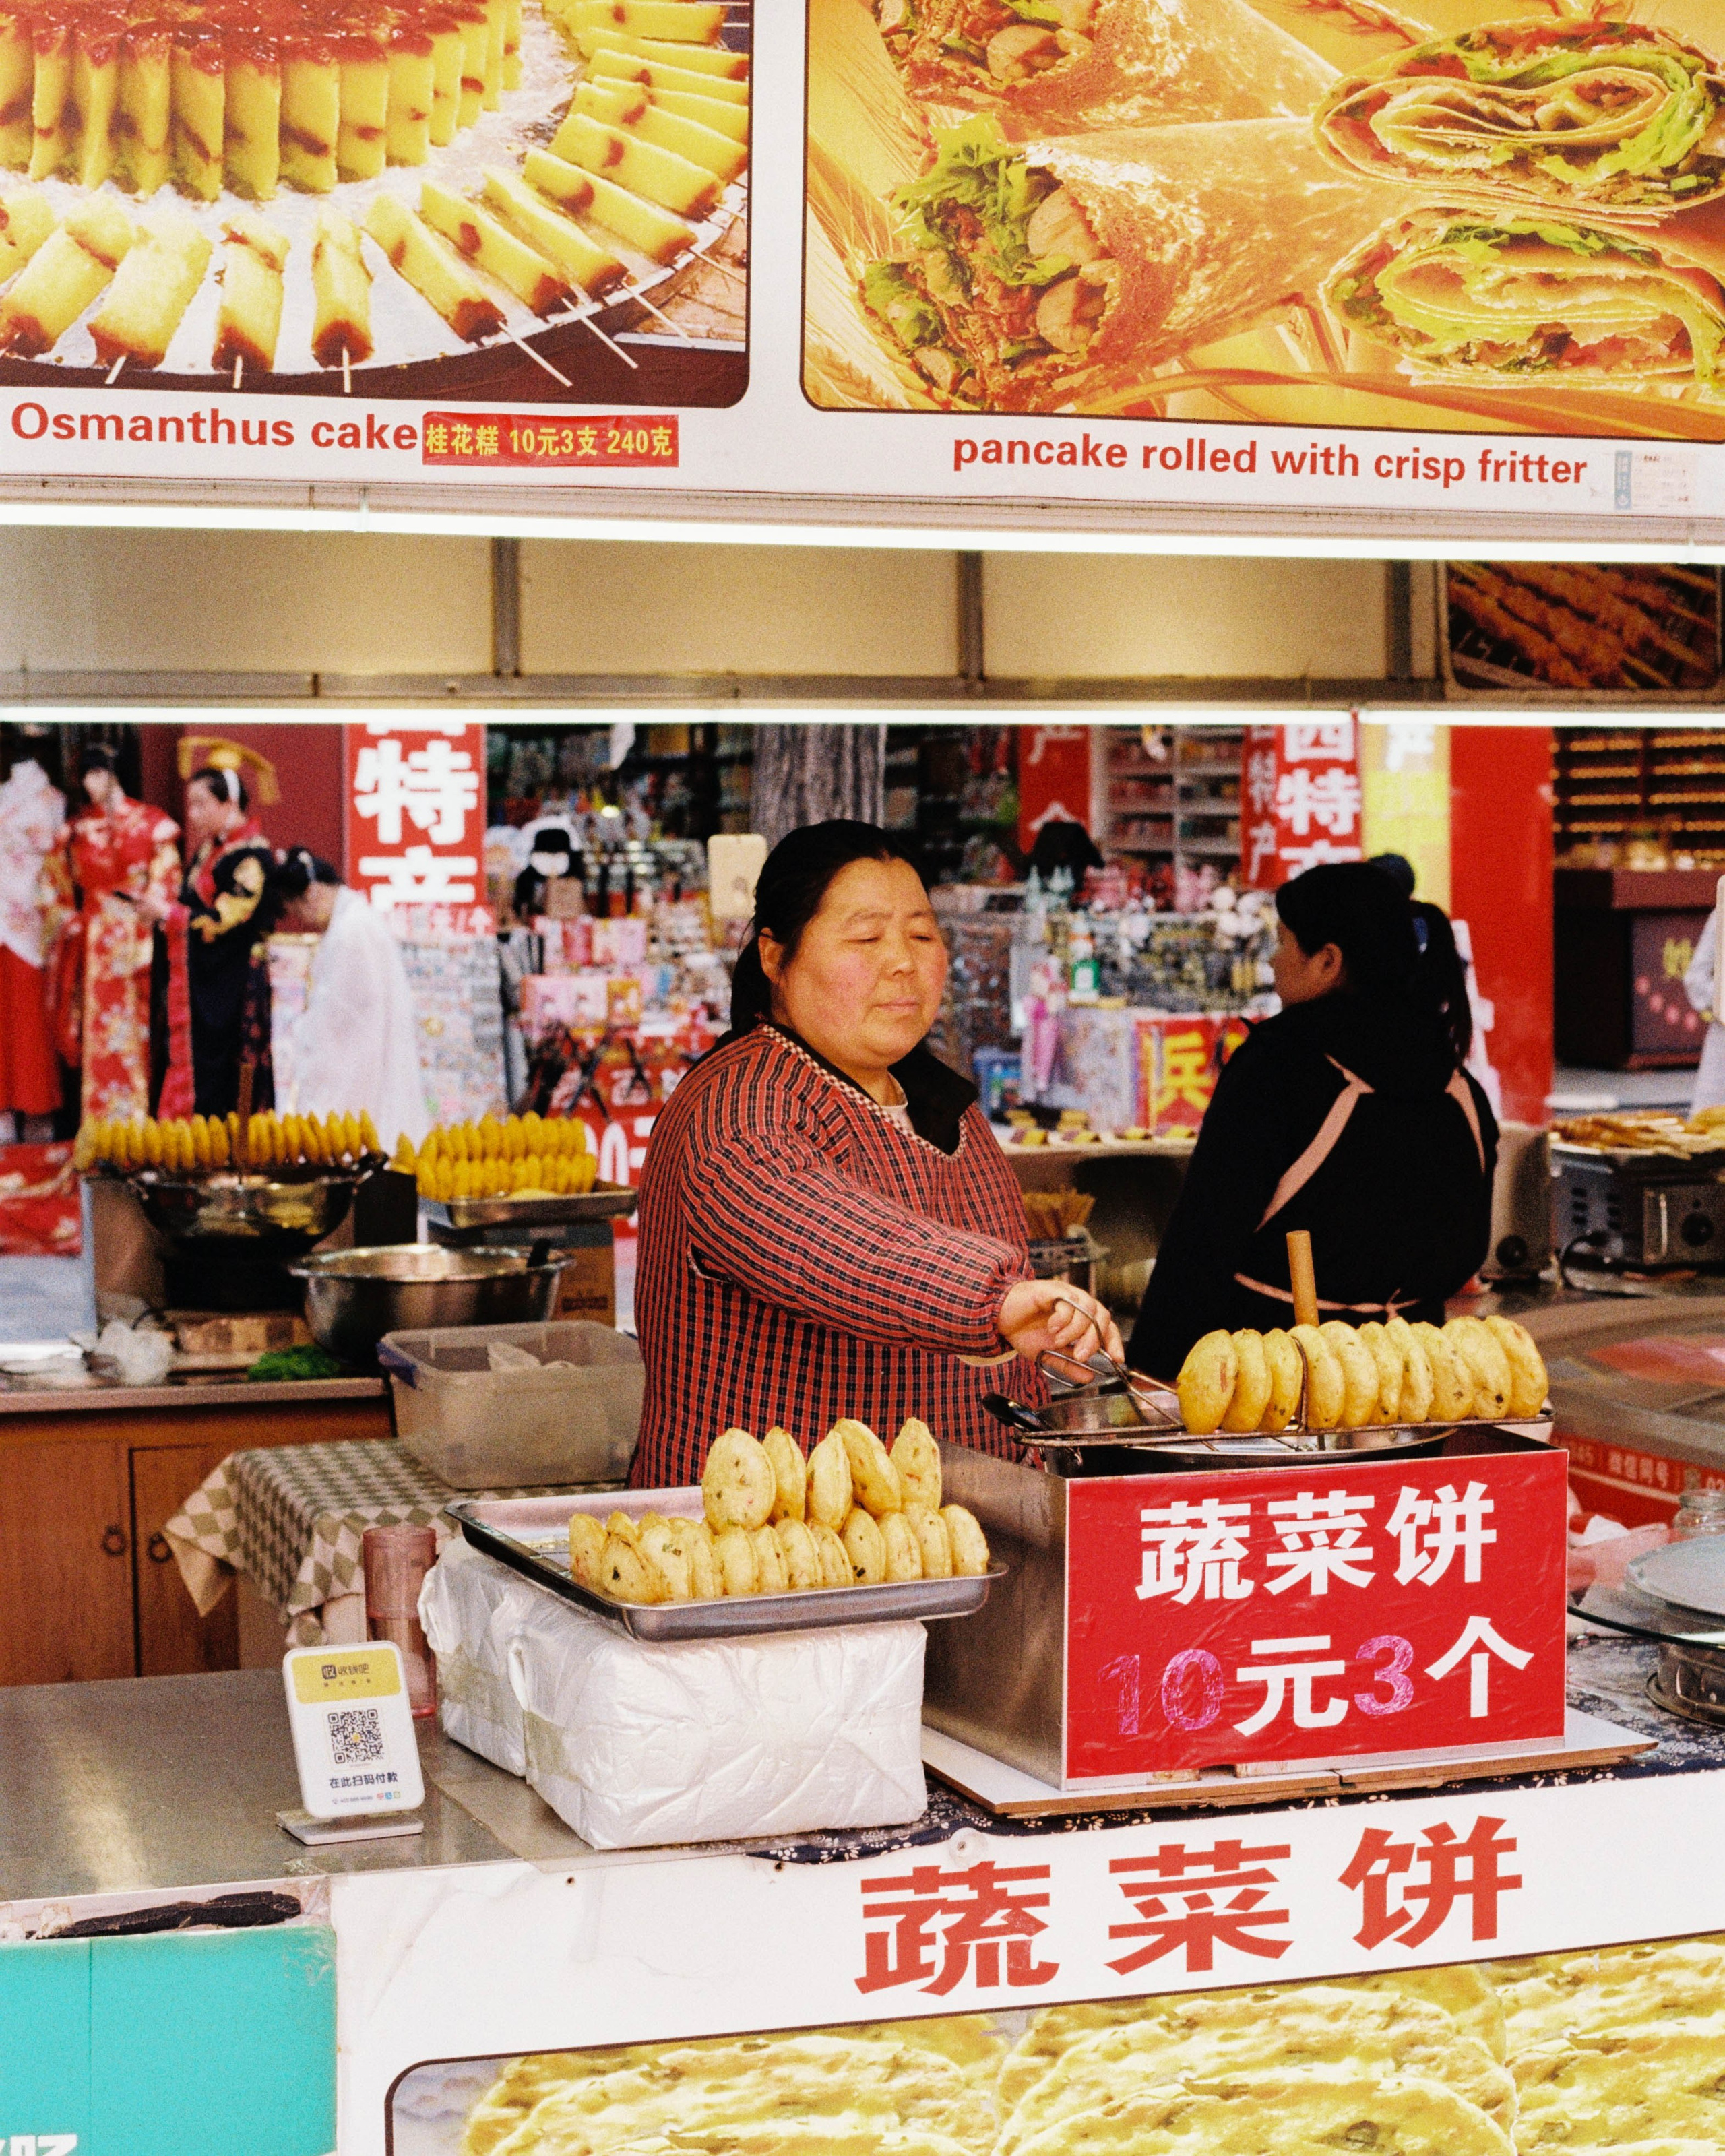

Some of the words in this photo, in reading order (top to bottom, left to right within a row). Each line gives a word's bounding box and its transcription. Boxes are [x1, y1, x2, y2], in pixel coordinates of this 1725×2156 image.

[11, 402, 295, 447] Osmanthus
[310, 412, 418, 451] cake
[426, 423, 499, 456] 桂花糕
[509, 424, 598, 457] 10元3支
[606, 425, 673, 457] 240克
[953, 432, 1128, 472] pancake
[1141, 437, 1257, 474] rolled
[1270, 442, 1360, 477] with
[1373, 451, 1466, 490] crisp
[1478, 448, 1588, 484] fritter
[353, 724, 479, 910] 特产
[1135, 1481, 1497, 1605] 蔬菜饼
[1098, 1616, 1535, 1738] 10元3个
[329, 1771, 398, 1789] 在此扫码付款
[854, 1816, 1522, 1996] 蔬菜饼
